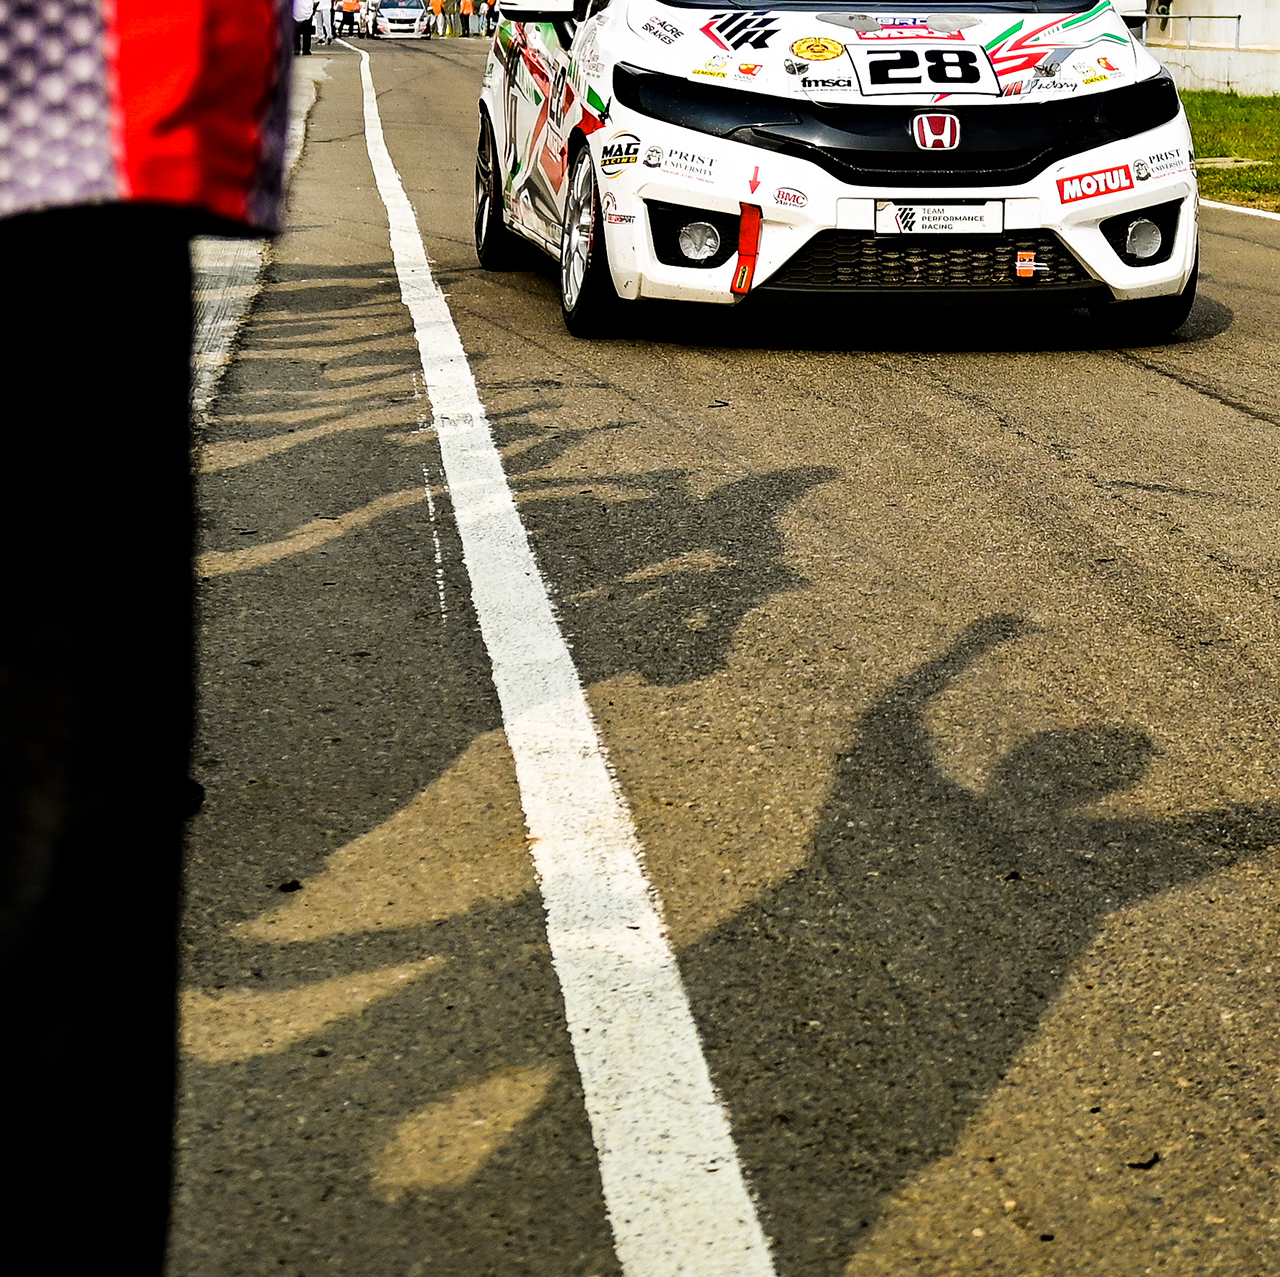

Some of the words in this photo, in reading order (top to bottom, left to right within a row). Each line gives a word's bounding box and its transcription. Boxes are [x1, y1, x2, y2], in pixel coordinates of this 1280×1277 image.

[641, 22, 676, 46] BRAKES
[866, 49, 981, 85] 28
[800, 76, 852, 88] fmsci
[601, 141, 642, 159] MAG
[668, 149, 718, 167] PRIST
[1148, 148, 1181, 164] PRIST
[1063, 168, 1131, 201] MOTUL
[777, 190, 805, 205] BMC
[922, 207, 945, 215] TEAM
[921, 223, 954, 231] RACING
